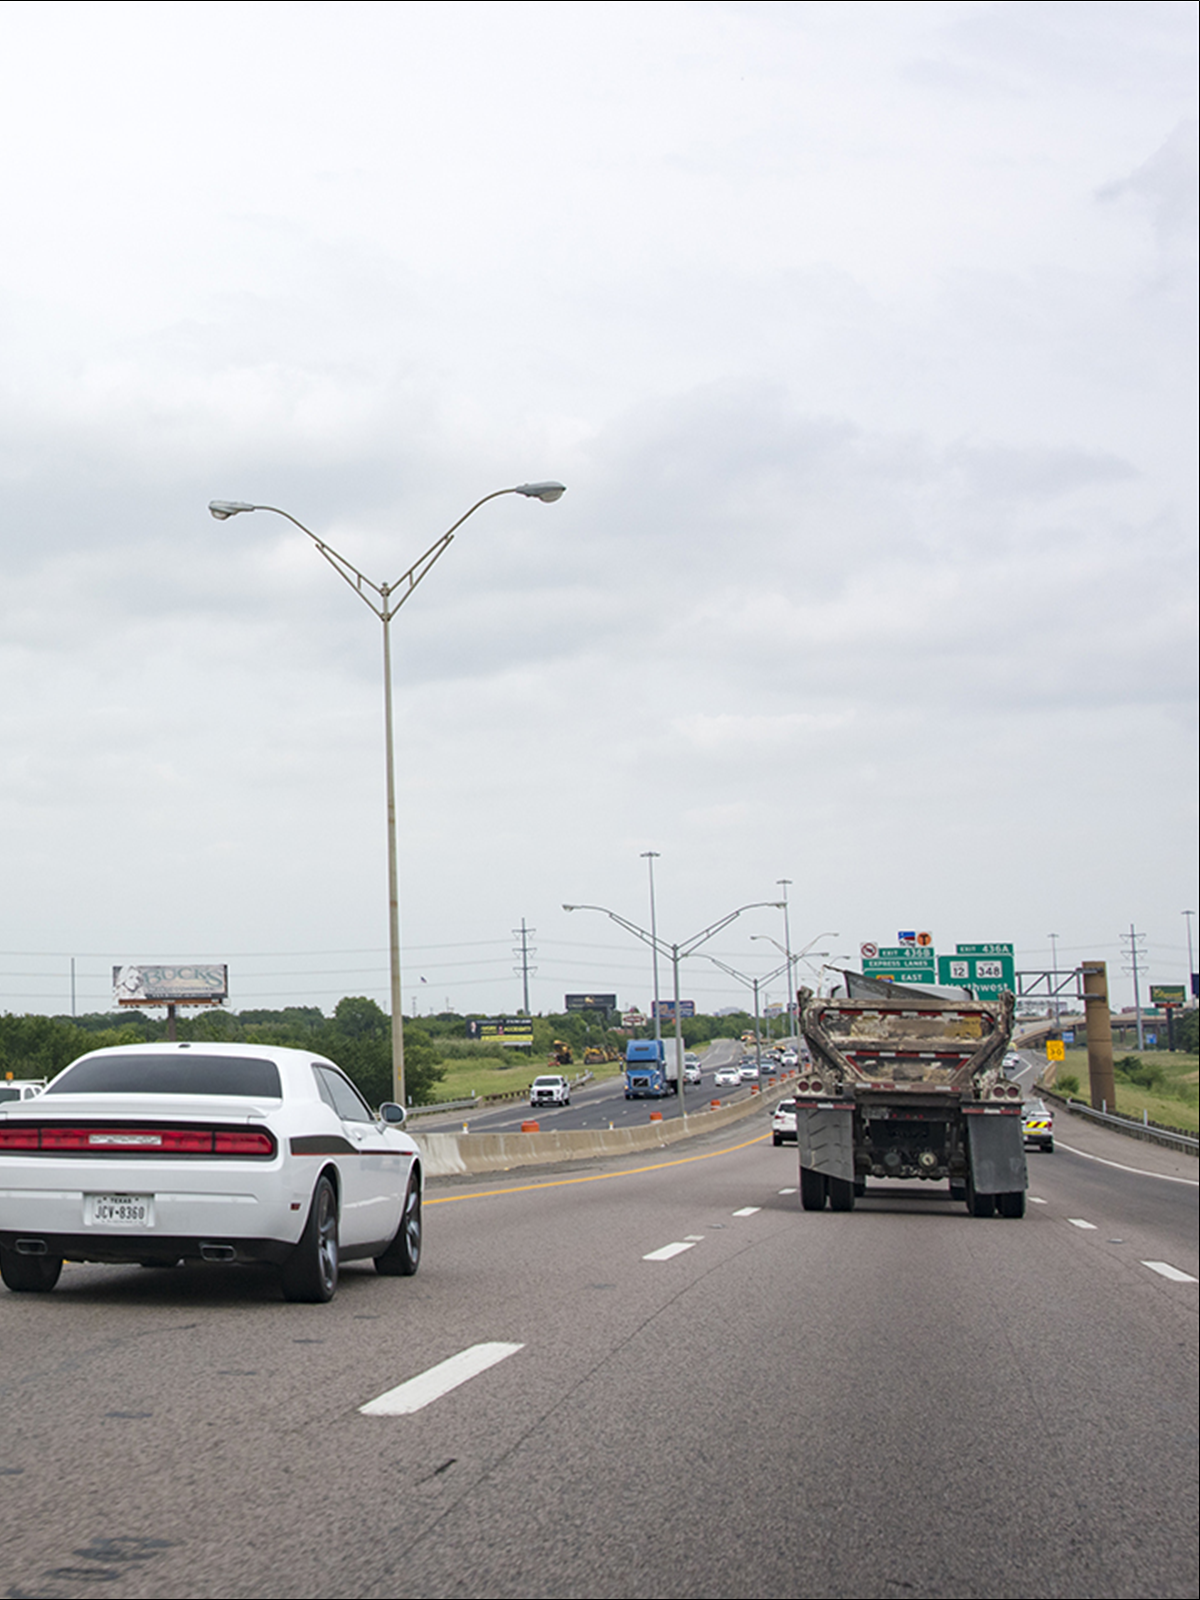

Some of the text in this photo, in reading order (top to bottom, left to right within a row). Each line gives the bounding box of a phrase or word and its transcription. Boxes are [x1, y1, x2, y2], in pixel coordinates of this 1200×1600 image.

[904, 948, 931, 957] 436B
[982, 945, 1010, 953] 436A
[953, 967, 965, 977] 12
[978, 966, 1000, 977] 348
[142, 966, 224, 988] BUCKS
